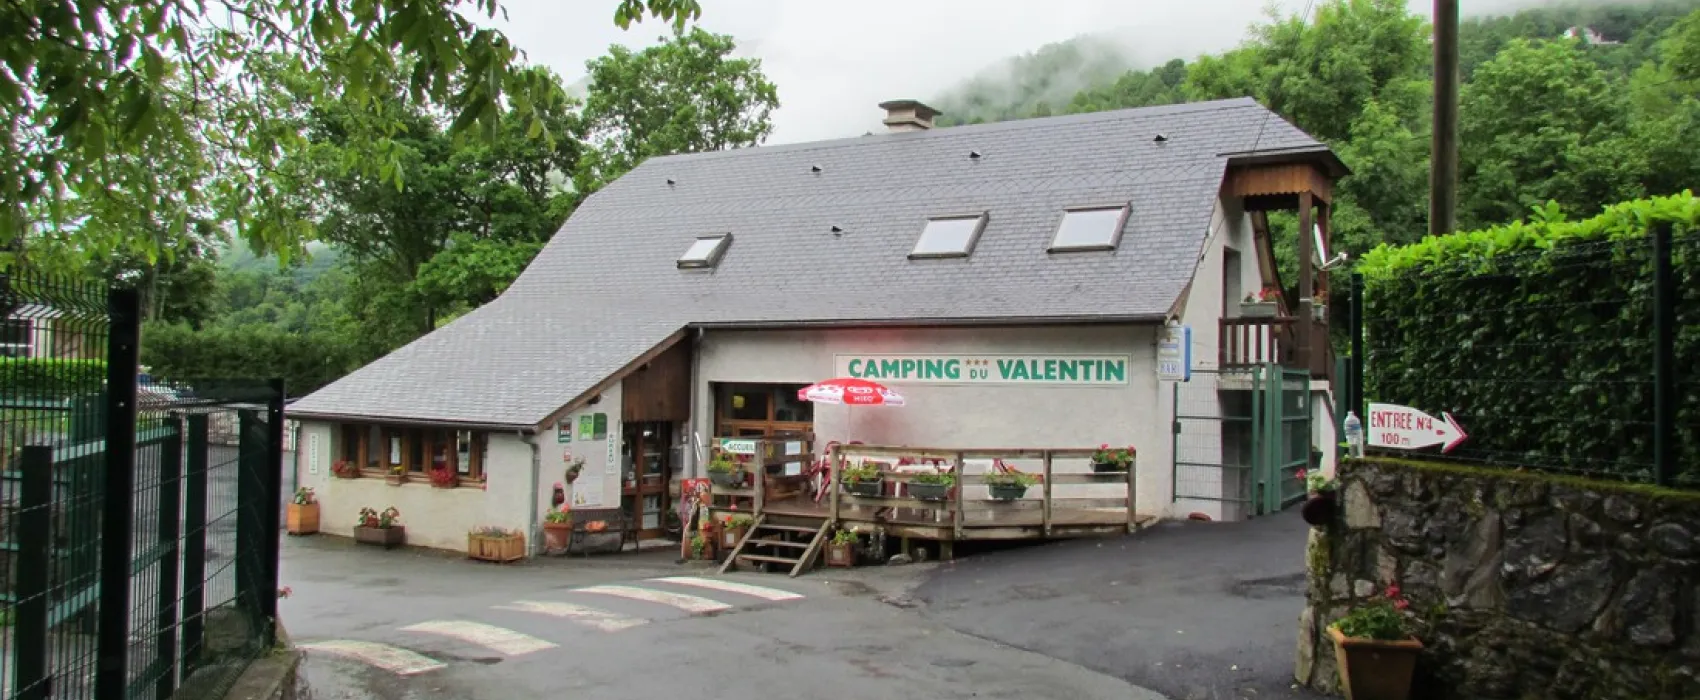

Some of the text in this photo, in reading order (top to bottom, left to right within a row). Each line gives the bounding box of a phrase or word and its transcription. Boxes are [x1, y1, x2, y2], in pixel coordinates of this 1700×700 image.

[848, 358, 1124, 381] CAMPING DU VALENTIN
[1381, 432, 1400, 444] 100
[728, 443, 754, 451] ACCUEIL
